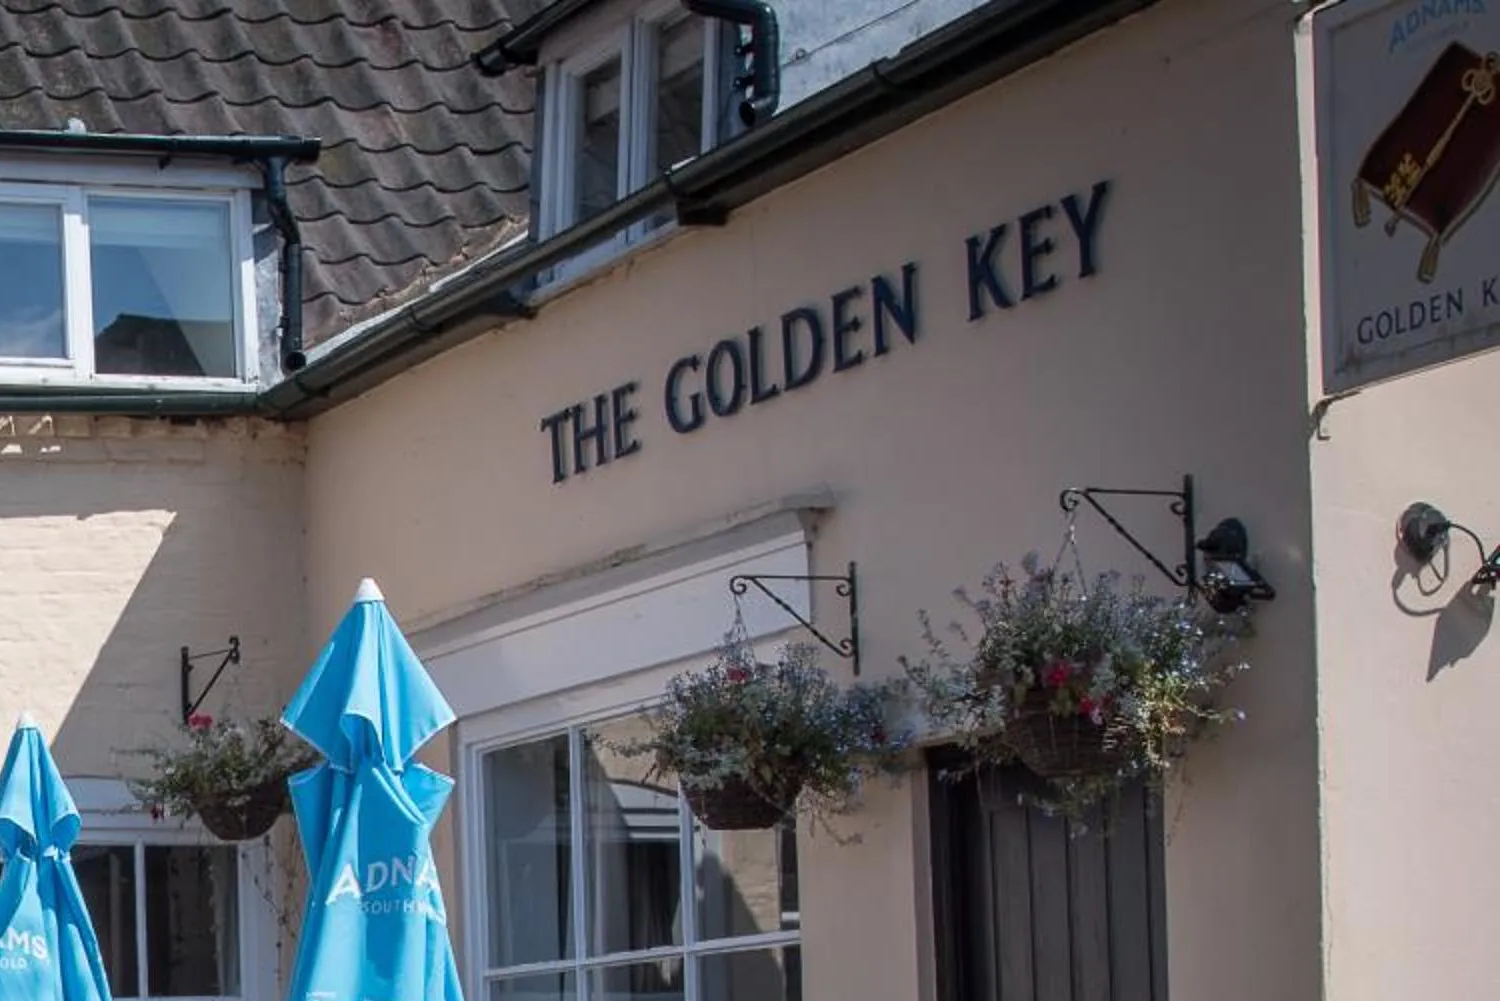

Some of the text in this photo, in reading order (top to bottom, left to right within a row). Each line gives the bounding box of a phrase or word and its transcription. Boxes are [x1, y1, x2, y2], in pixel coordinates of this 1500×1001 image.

[540, 181, 1110, 484] THE GOLDEN KEY
[1357, 286, 1464, 345] GOLDEN
